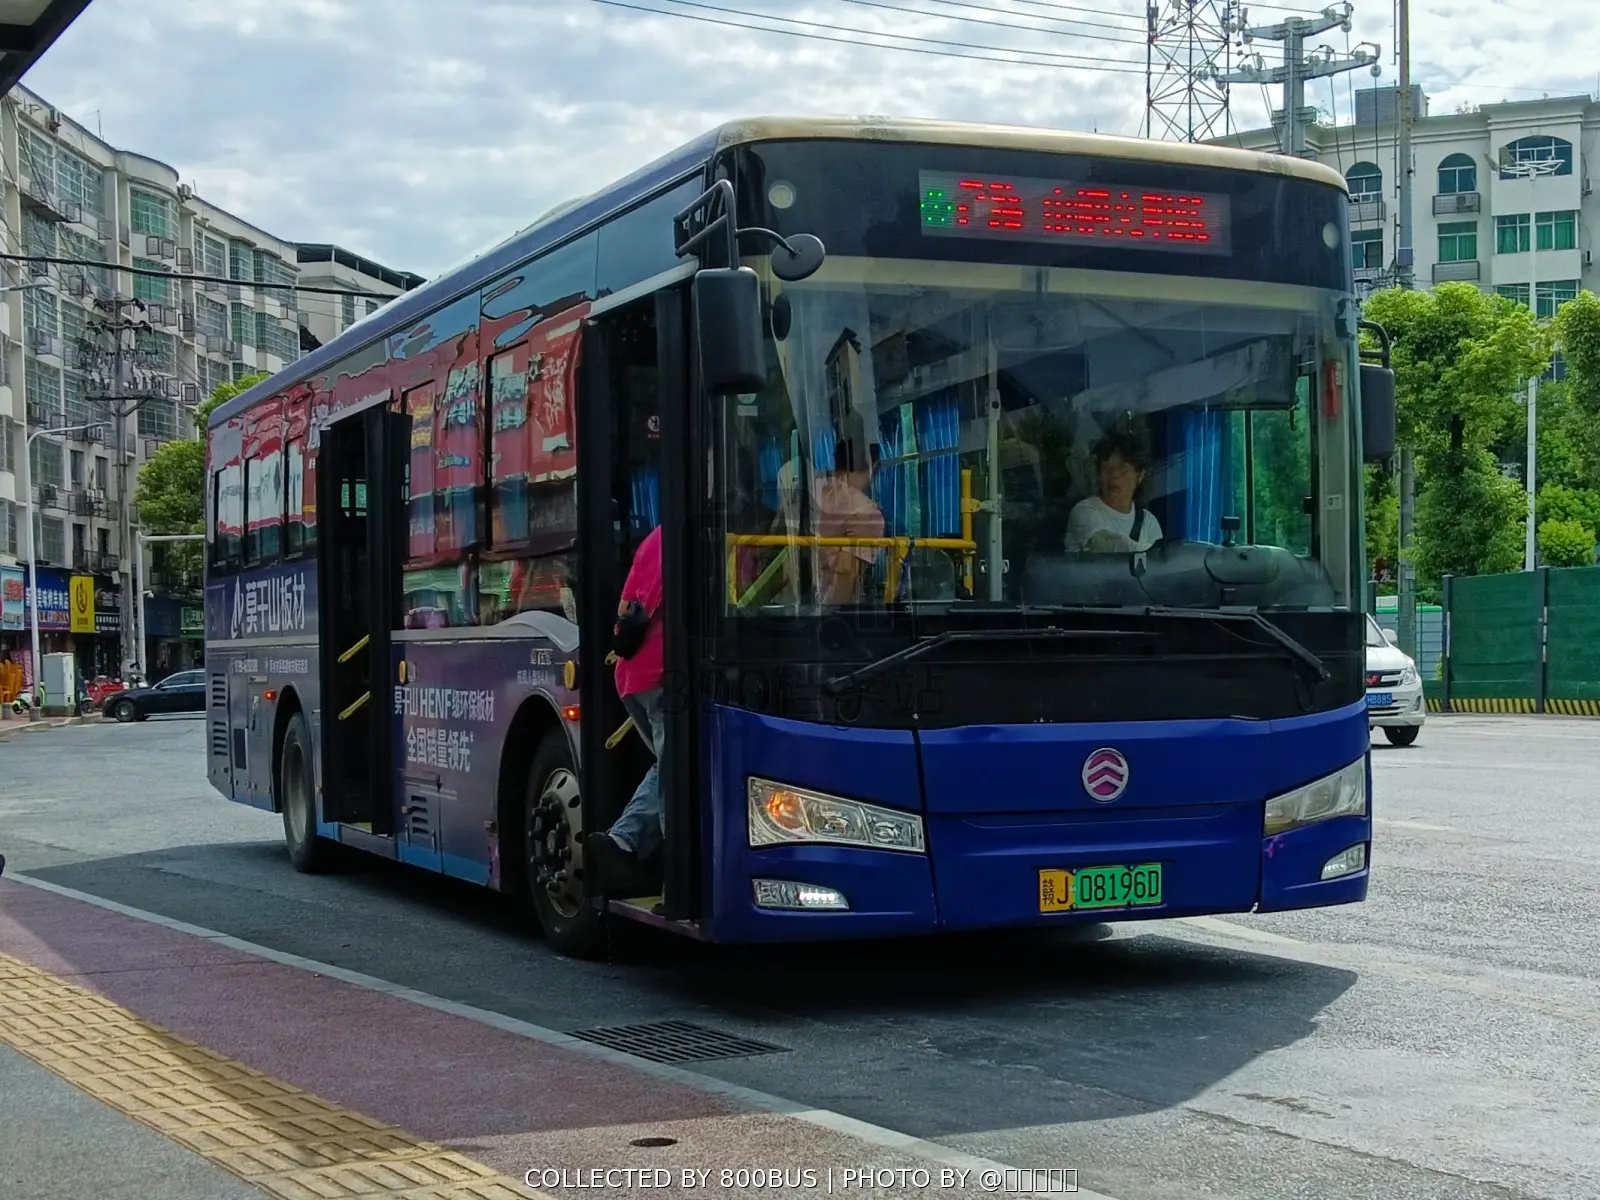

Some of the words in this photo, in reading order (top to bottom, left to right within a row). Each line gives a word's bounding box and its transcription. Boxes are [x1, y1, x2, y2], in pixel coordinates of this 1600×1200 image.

[246, 573, 305, 633] 莫干山板材
